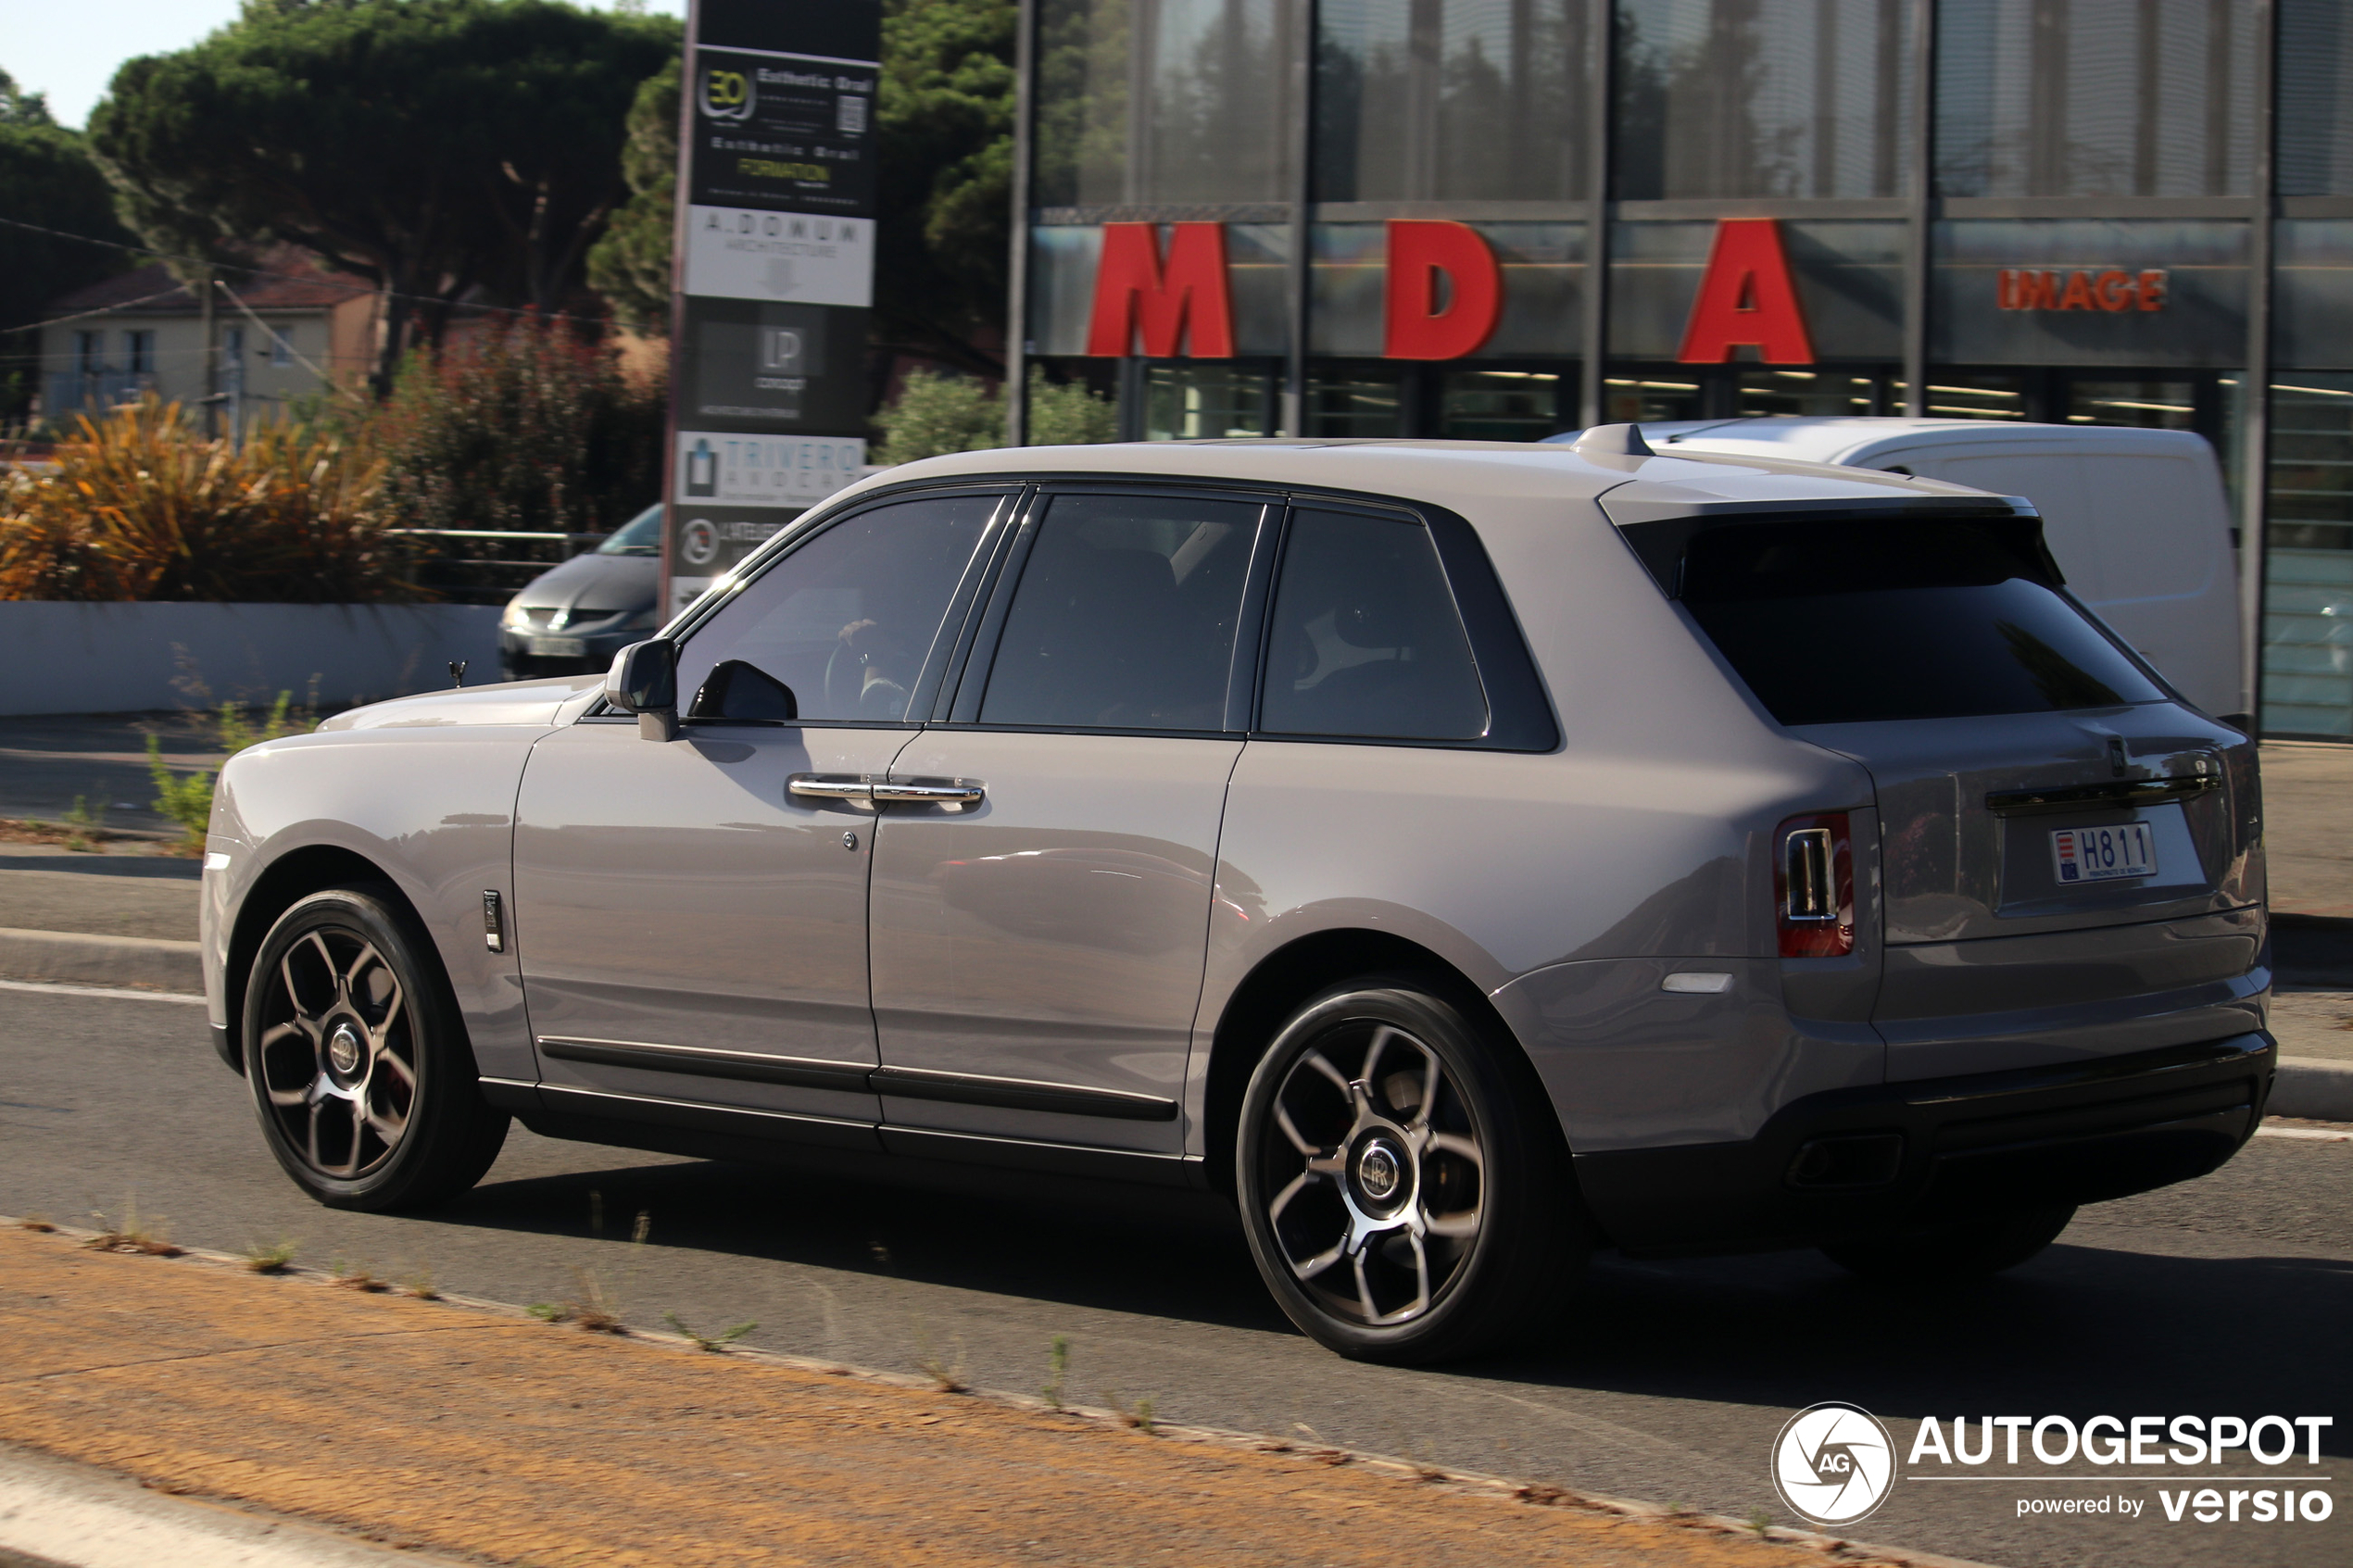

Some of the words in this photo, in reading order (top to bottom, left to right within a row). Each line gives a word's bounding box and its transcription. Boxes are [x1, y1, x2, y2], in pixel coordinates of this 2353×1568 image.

[1997, 270, 2168, 312] IMAGE
[724, 441, 859, 471] TRIVERO
[2082, 827, 2146, 869] H811
